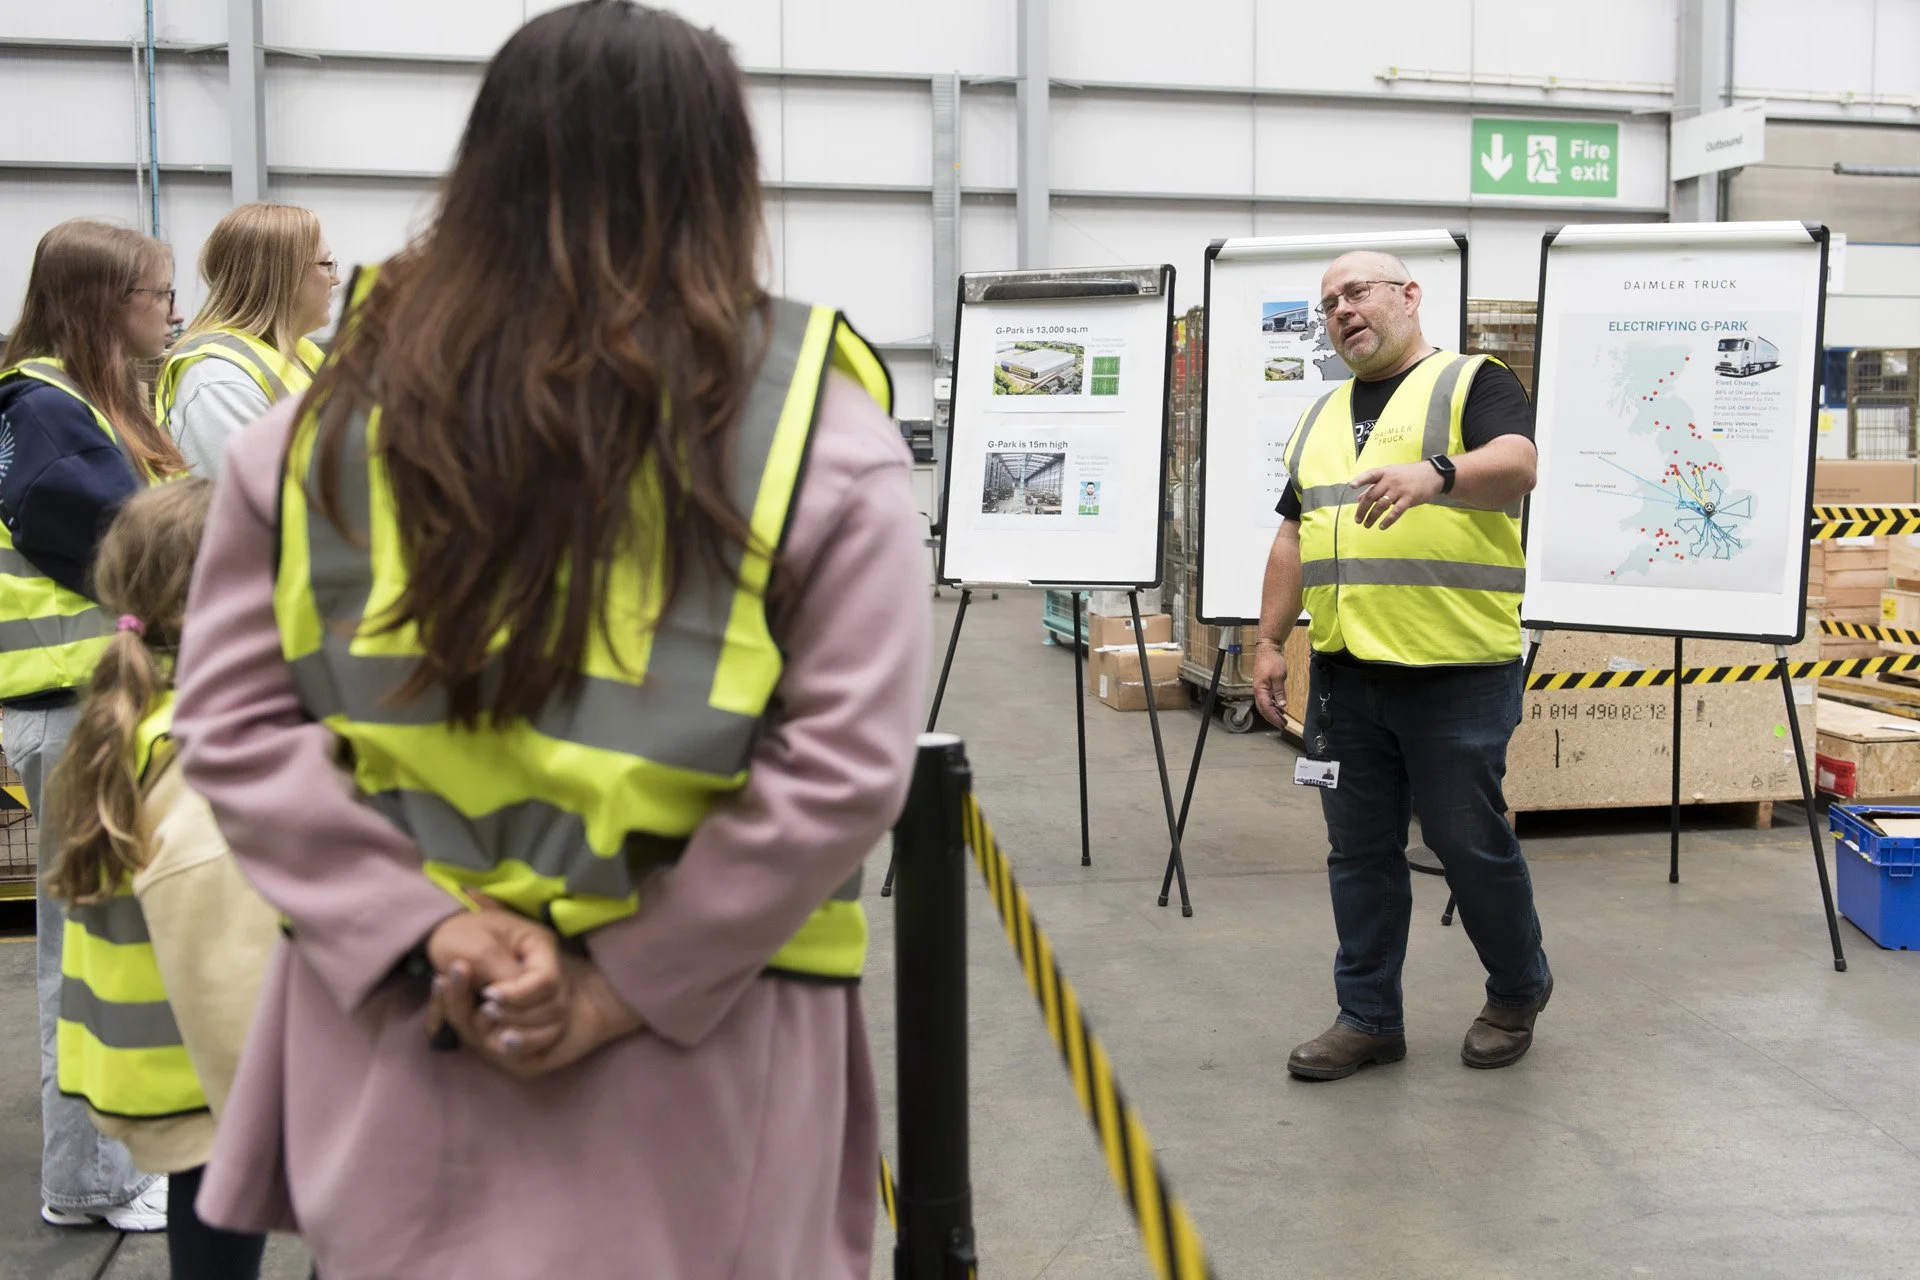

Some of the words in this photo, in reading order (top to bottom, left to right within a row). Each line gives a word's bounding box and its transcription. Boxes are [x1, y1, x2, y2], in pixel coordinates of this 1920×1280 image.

[1570, 139, 1610, 160] Fire
[1704, 134, 1744, 154] Outbound
[1570, 162, 1609, 182] exit
[1624, 280, 1685, 290] DAIMLER
[1694, 280, 1736, 289] TRUCK
[996, 326, 1024, 335] G-Park
[1026, 326, 1034, 334] is
[1066, 326, 1088, 335] sq.m
[1609, 321, 1697, 332] ELECTRIFYING
[1701, 320, 1748, 331] G-PARK
[1374, 425, 1412, 440] DAIMLER
[987, 440, 1017, 448] G-Park
[1019, 440, 1026, 448] is
[1029, 440, 1047, 448] 15m
[1050, 440, 1068, 450] high
[1379, 434, 1404, 446] TRUCK
[1532, 703, 1541, 719] A
[1550, 703, 1578, 720] 014
